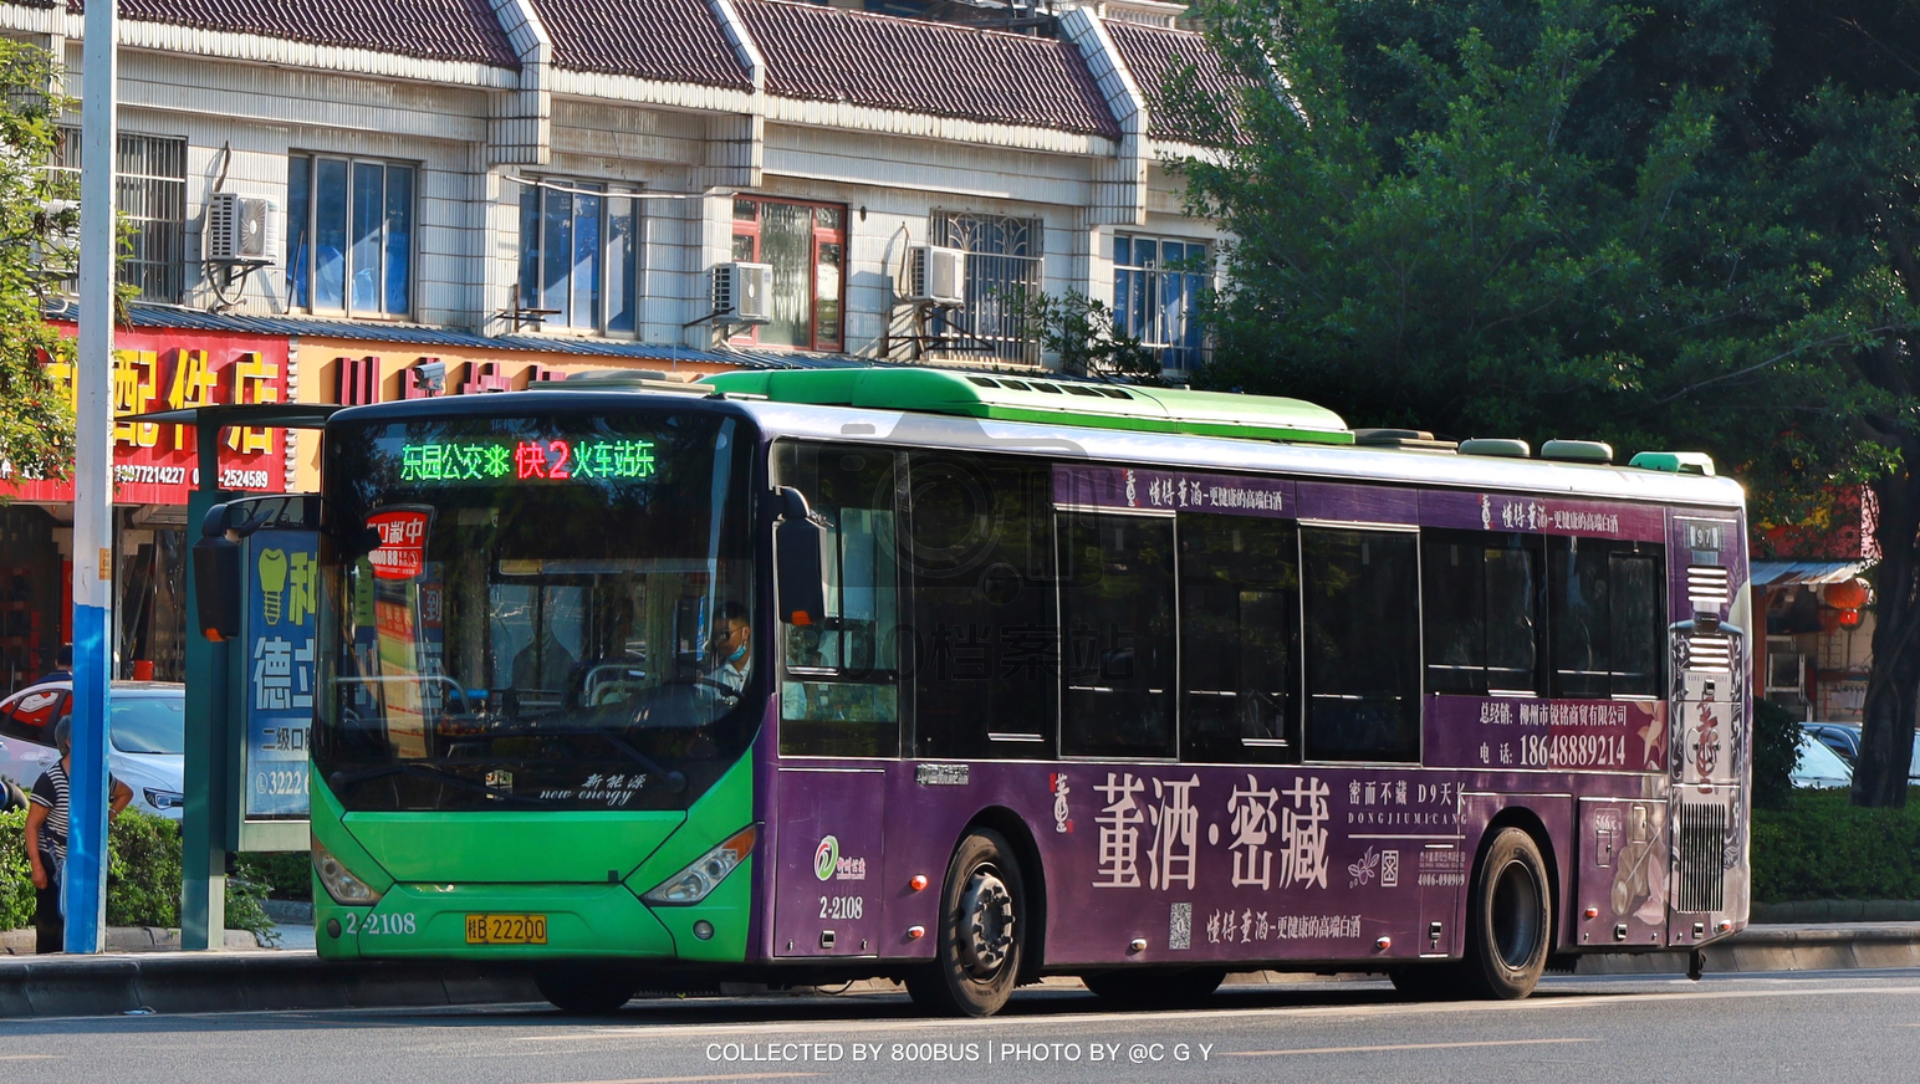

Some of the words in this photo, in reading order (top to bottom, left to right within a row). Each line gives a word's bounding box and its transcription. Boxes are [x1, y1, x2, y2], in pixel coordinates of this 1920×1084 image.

[401, 443, 483, 481] 东园公交
[515, 440, 569, 479] 快2
[572, 439, 655, 478] 火车站东
[1520, 735, 1625, 766] 18648889214
[581, 773, 647, 790] 新能源
[1348, 779, 1408, 806] 密而不藏
[1418, 781, 1466, 806] D9天长
[539, 789, 573, 799] new
[578, 789, 635, 806] energy
[1092, 772, 1330, 891] 董酒·密藏
[1348, 812, 1467, 826] DONGJIUMICANG
[819, 895, 863, 919] 2-2108
[346, 911, 416, 936] 2-2108
